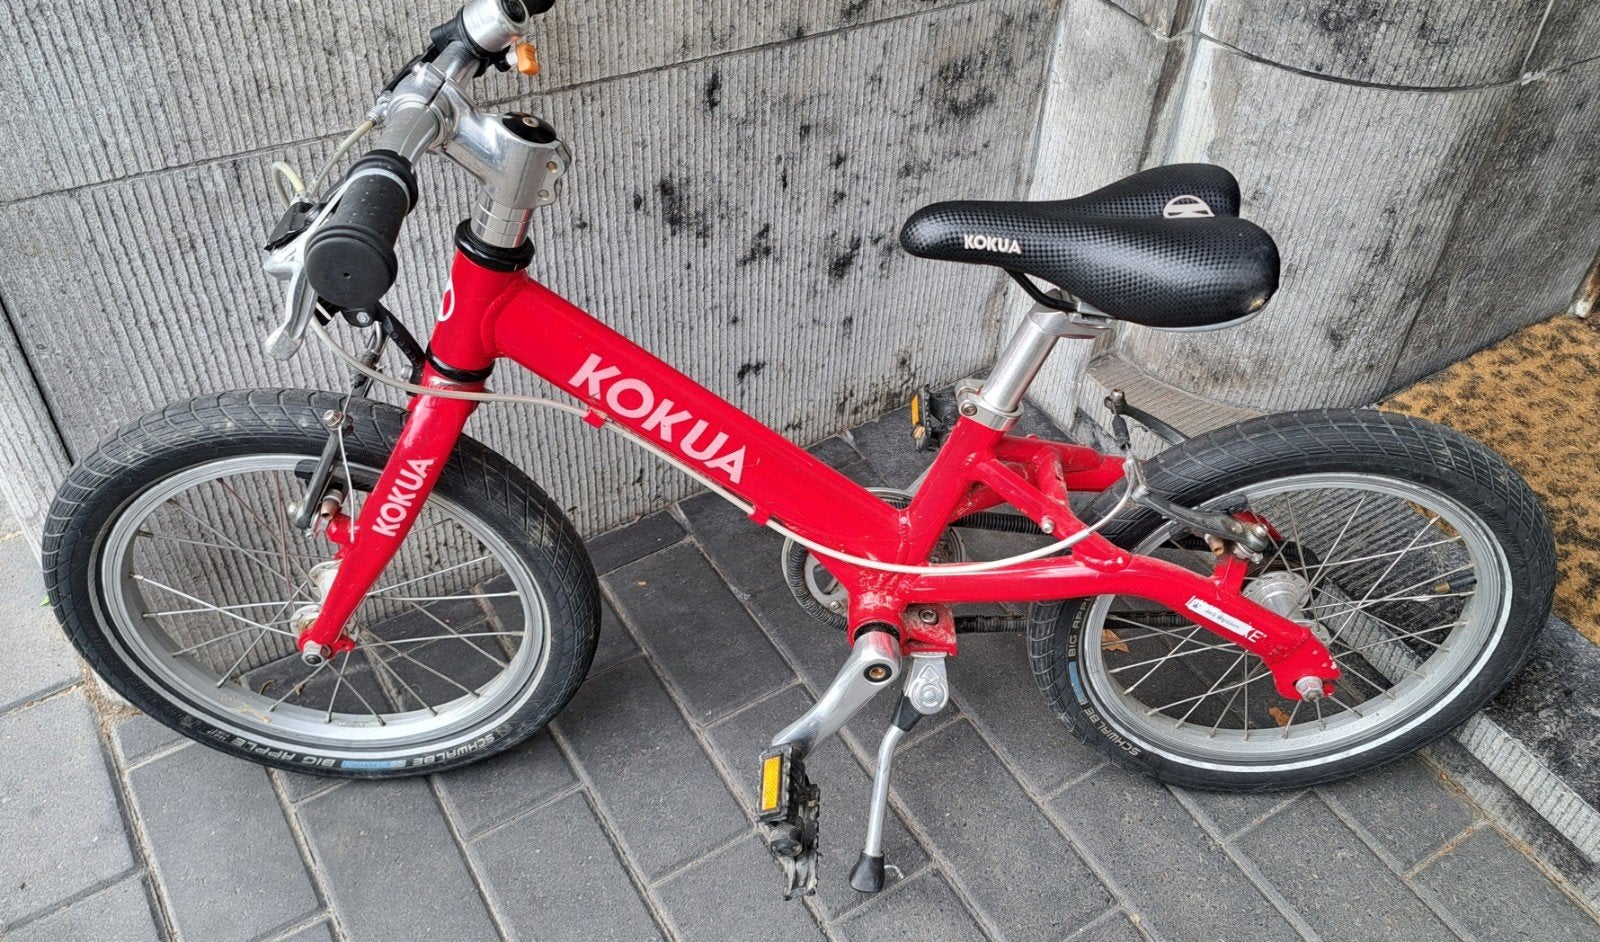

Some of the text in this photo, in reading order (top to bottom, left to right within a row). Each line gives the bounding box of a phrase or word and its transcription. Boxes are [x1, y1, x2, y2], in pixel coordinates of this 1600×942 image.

[963, 233, 1022, 255] KOKUA
[568, 352, 747, 485] KOKUA
[371, 457, 434, 539] KOKUA
[1072, 596, 1092, 629] APPL
[1068, 634, 1078, 657] BIG
[1083, 707, 1142, 757] SCHWALBE
[232, 738, 294, 760] APPLE
[301, 757, 336, 767] BIG
[412, 734, 496, 766] SCHWALBE
